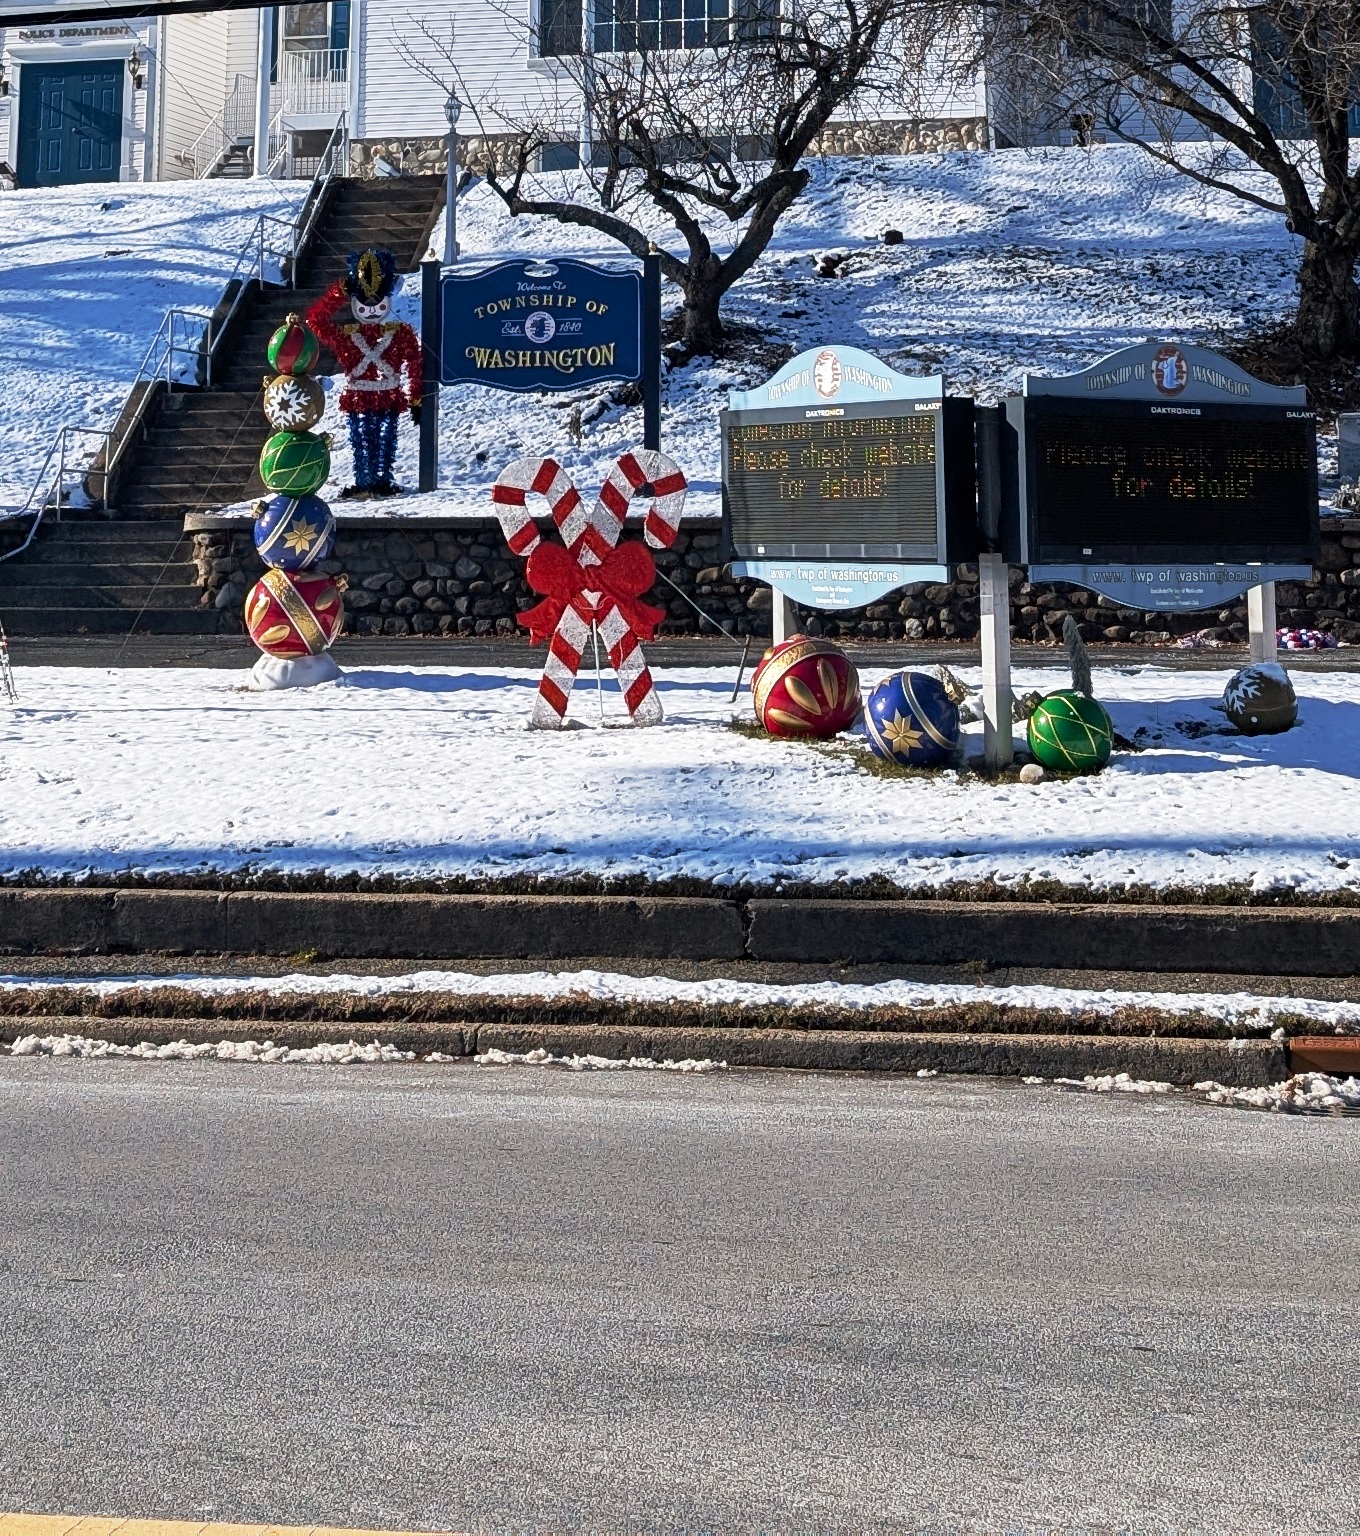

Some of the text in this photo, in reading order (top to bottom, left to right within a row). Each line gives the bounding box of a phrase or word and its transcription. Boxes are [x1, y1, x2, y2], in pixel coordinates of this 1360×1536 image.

[18, 26, 131, 40] POLICE DEPARTMENT
[516, 281, 552, 292] Welcome
[473, 294, 609, 320] TOWNSHIP OF
[558, 322, 582, 333] 1840
[465, 341, 616, 374] WASHINGTON
[767, 373, 800, 401] TOWNSHIP
[801, 368, 811, 387] OF
[843, 365, 893, 394] WASHINGTON
[1085, 365, 1132, 391] TOWNSHIP
[1133, 363, 1147, 381] OF
[1191, 364, 1251, 398] WASHINGTON
[1150, 405, 1202, 416] DAKTRONICS
[800, 440, 853, 468] check
[777, 472, 808, 499] for
[1111, 468, 1154, 498] for
[797, 566, 815, 583] twp
[817, 566, 828, 581] of
[830, 567, 899, 584] washington.us
[1130, 569, 1155, 585] twp
[1158, 568, 1171, 583] of
[1175, 569, 1260, 585] washington.us
